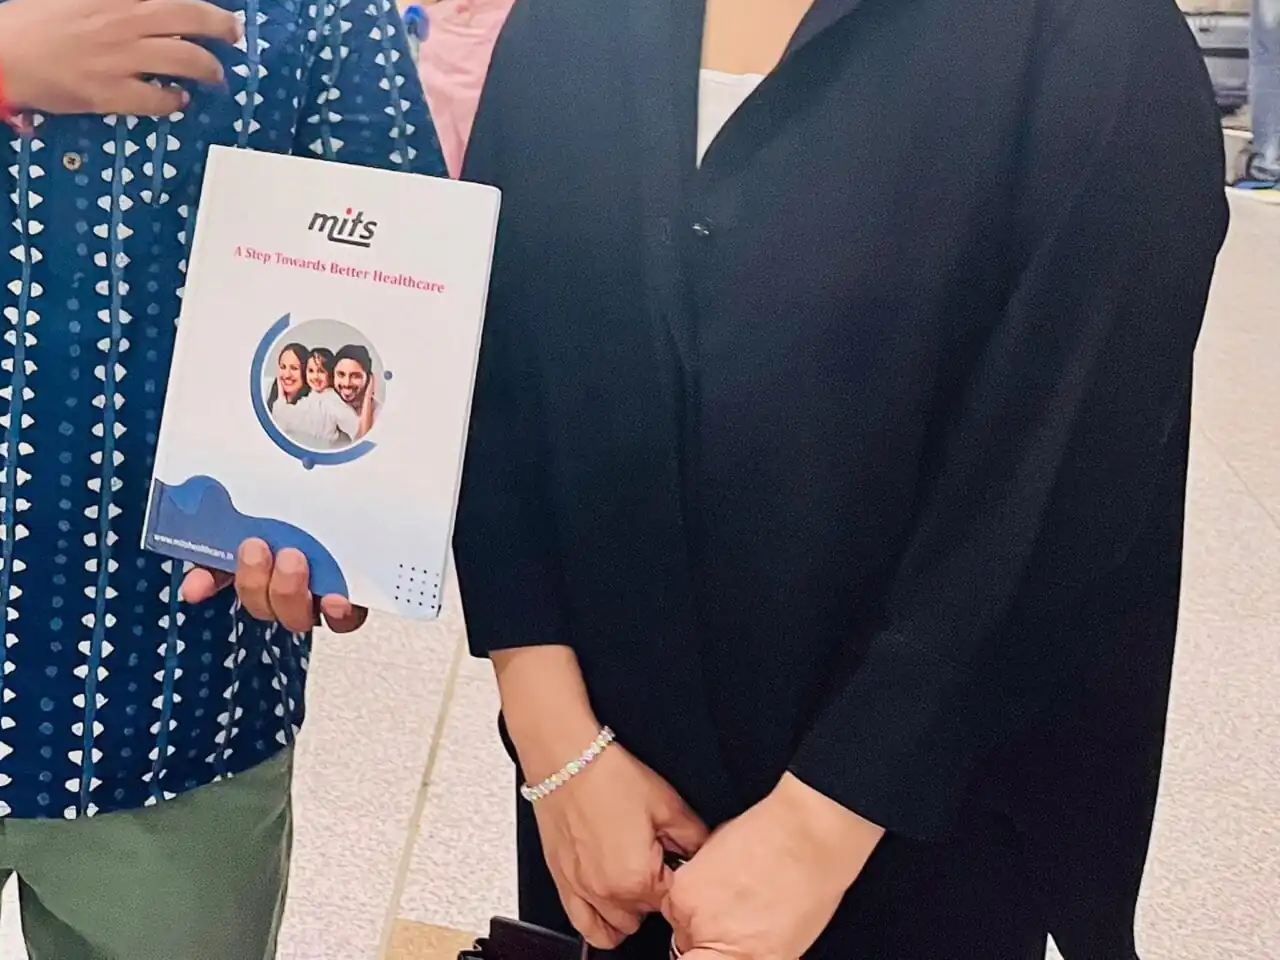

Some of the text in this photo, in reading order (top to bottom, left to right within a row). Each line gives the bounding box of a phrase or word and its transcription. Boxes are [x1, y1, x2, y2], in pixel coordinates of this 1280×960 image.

[307, 207, 377, 248] mits
[233, 246, 445, 294] A Step Towards Better Healthcare
